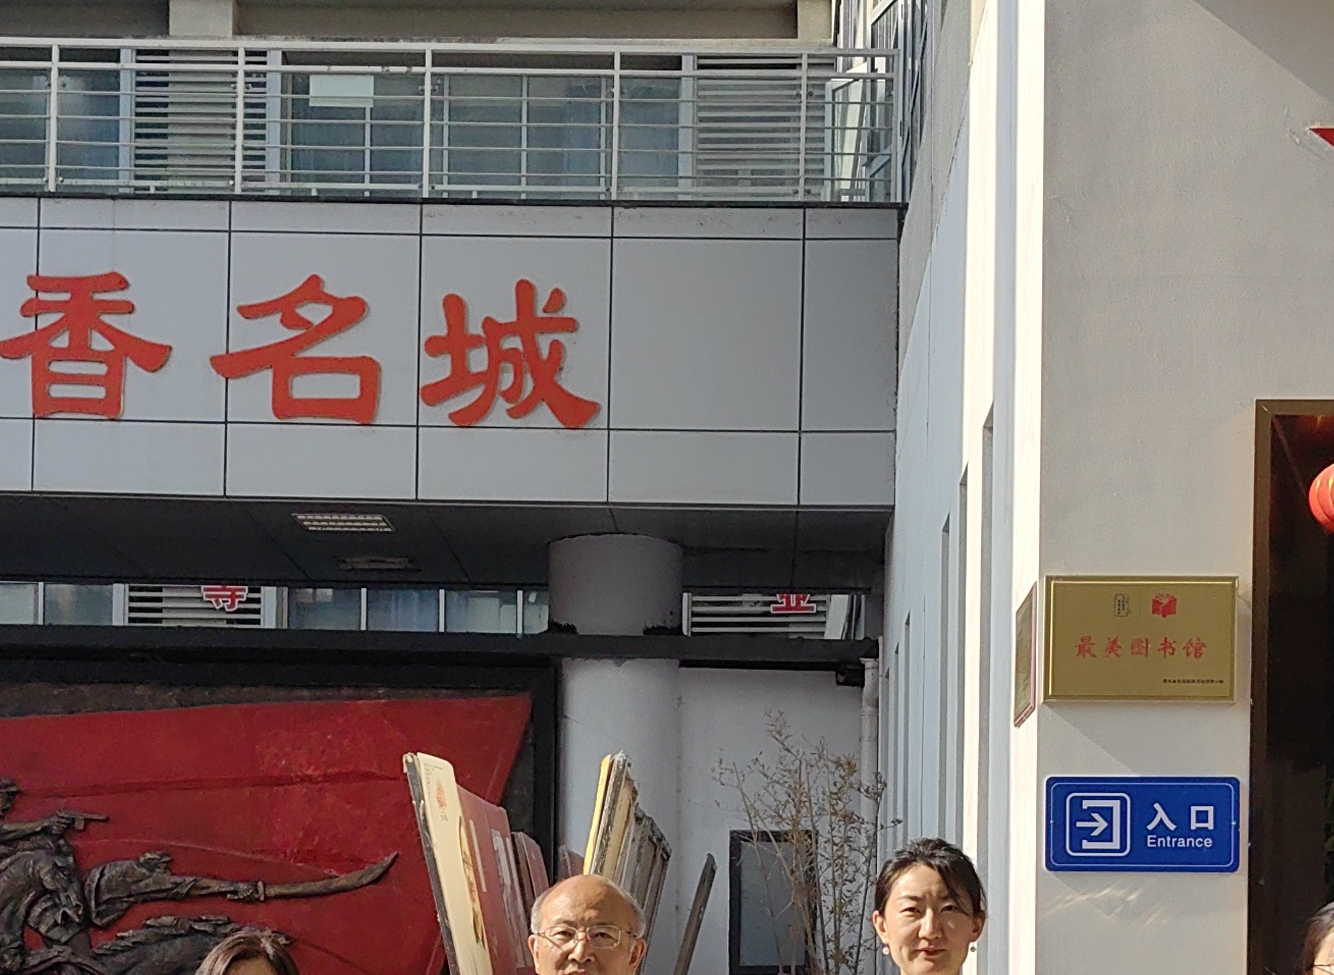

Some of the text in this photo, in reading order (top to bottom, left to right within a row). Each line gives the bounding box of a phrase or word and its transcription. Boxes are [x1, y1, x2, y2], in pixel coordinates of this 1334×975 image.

[1074, 635, 1207, 659] 最美图书馆
[1146, 801, 1215, 831] 入口
[1146, 834, 1213, 849] Entrance
